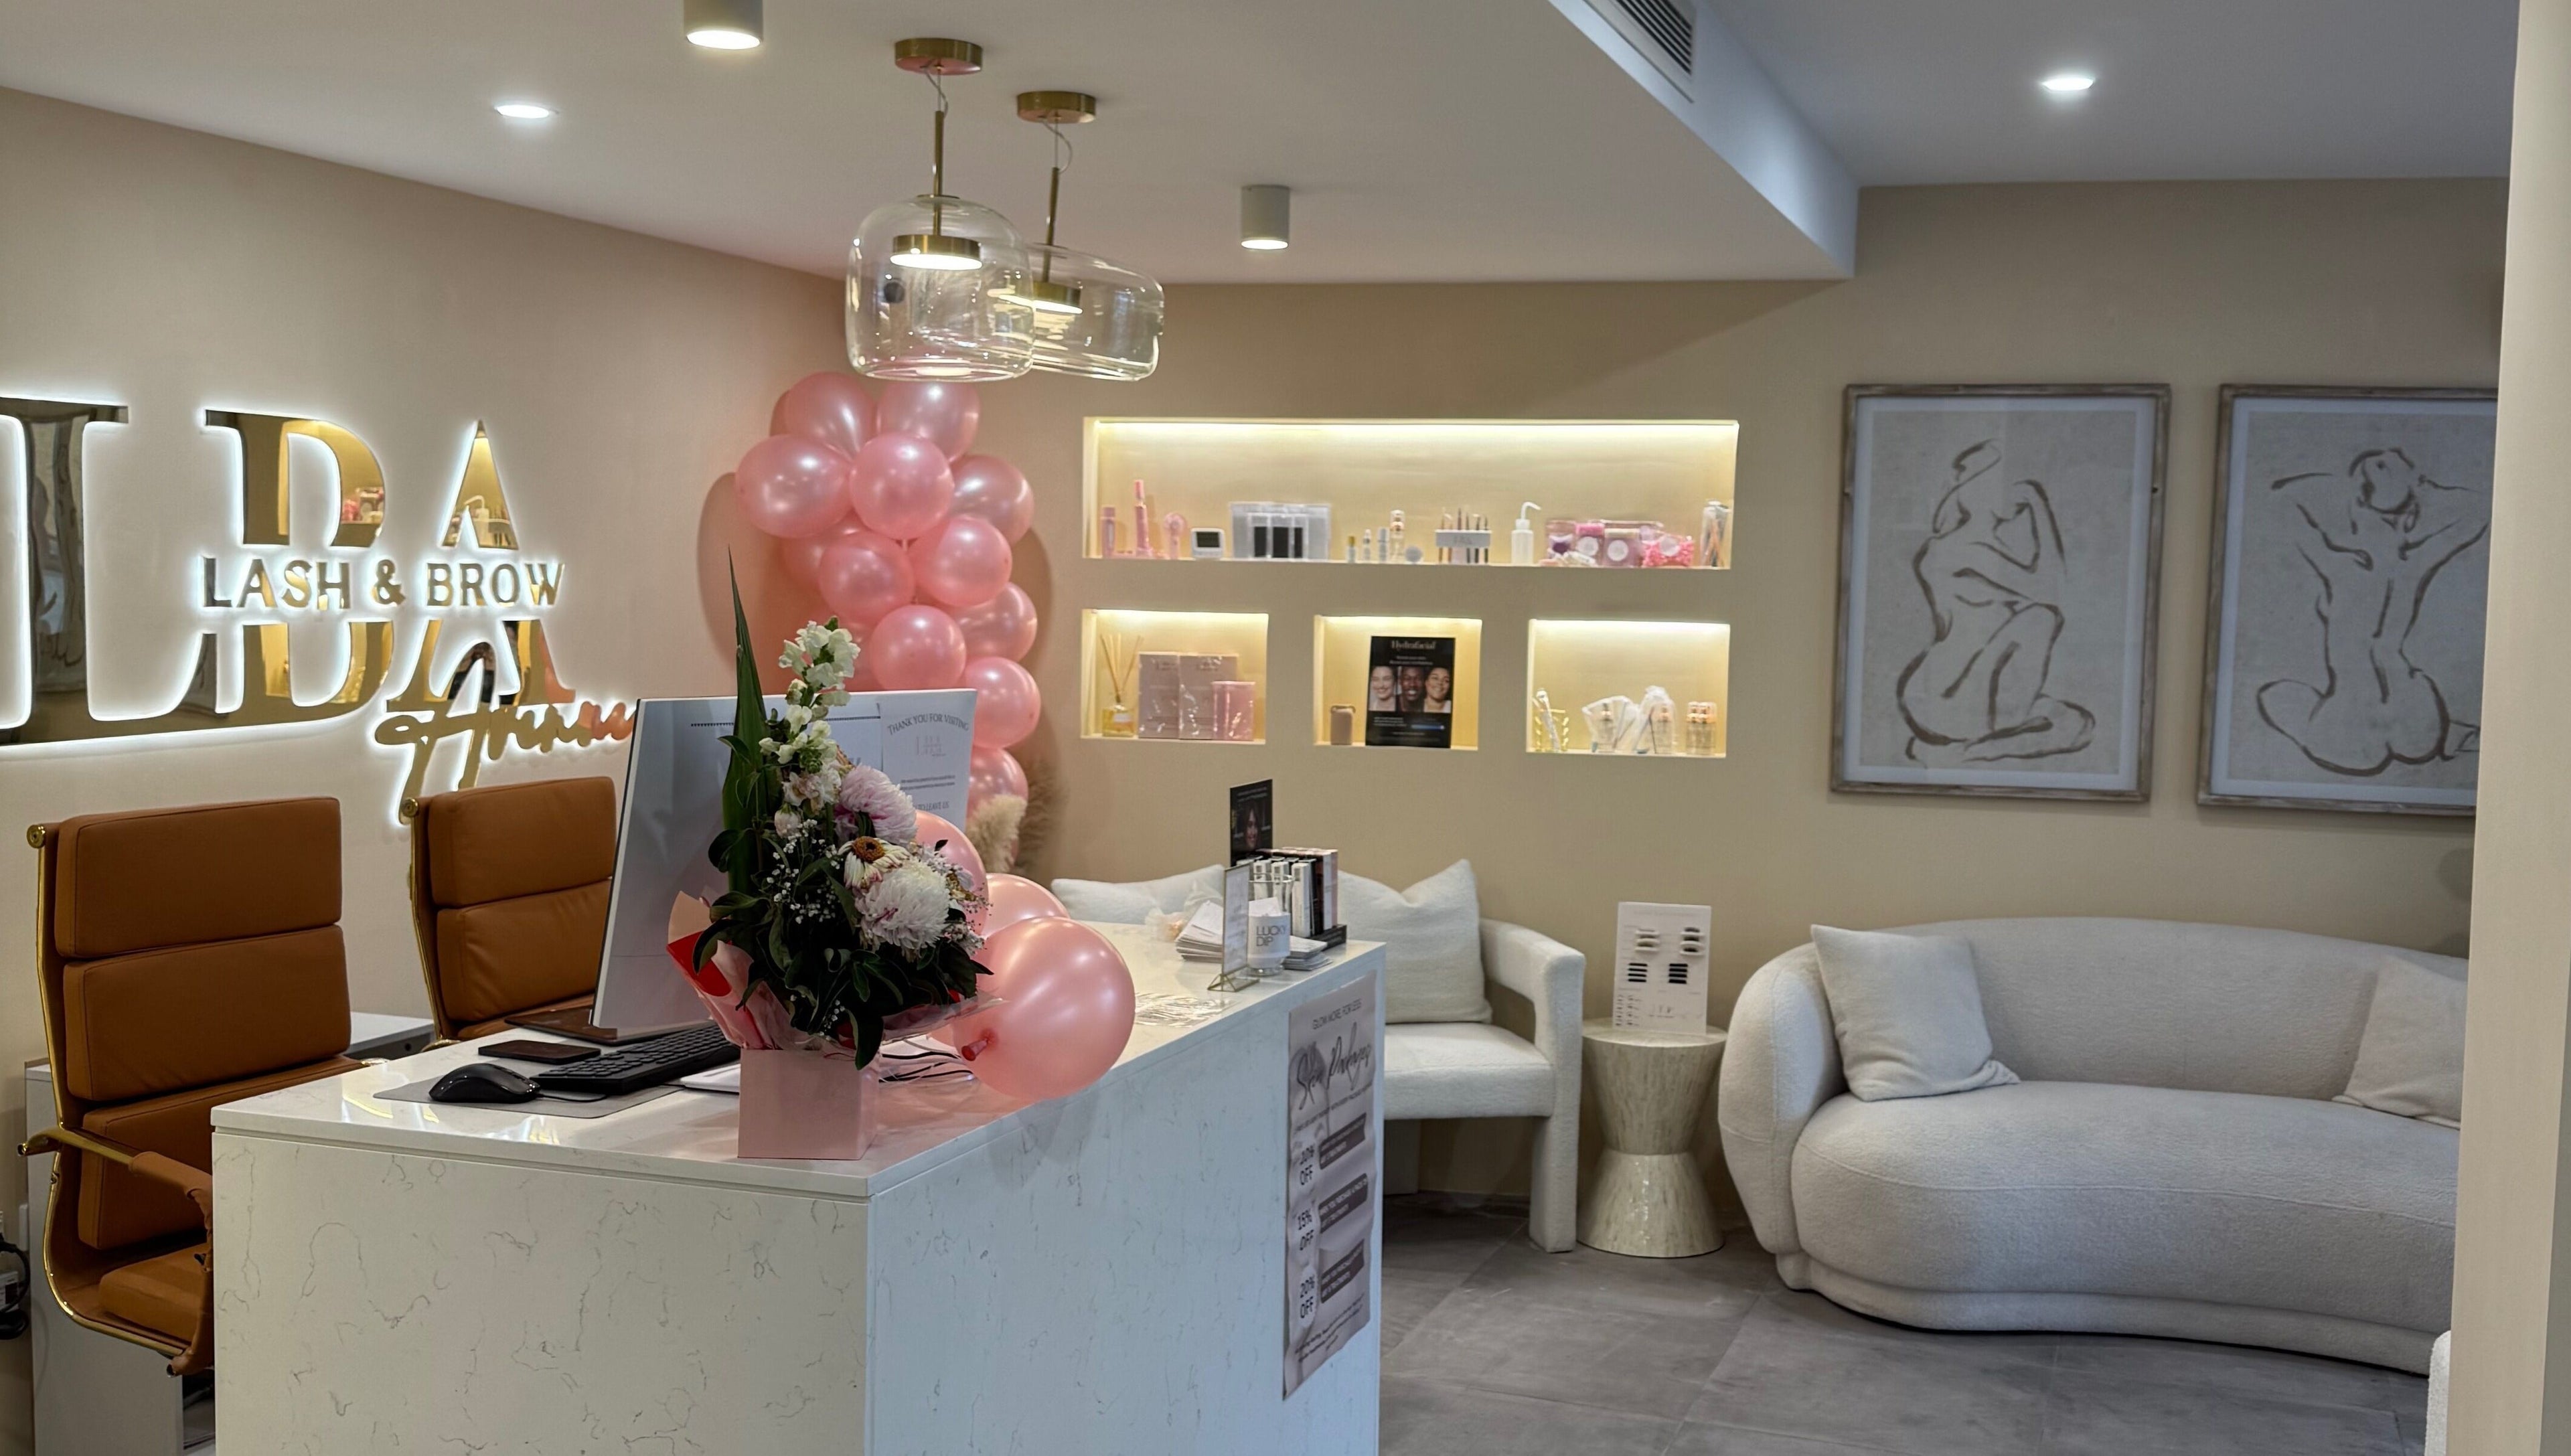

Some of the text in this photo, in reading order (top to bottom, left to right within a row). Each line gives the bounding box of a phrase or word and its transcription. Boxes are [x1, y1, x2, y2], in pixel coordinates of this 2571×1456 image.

[202, 557, 565, 610] LASH & BROW
[887, 713, 969, 736] THANK YOU FOR VISITING
[1256, 924, 1287, 936] LUCKY
[1256, 936, 1274, 947] DIP
[1299, 1164, 1314, 1186] OFF
[1298, 1207, 1313, 1230] 15%
[1299, 1228, 1314, 1251] OFF
[1300, 1274, 1316, 1299] 20%
[1300, 1295, 1314, 1319] OFF
